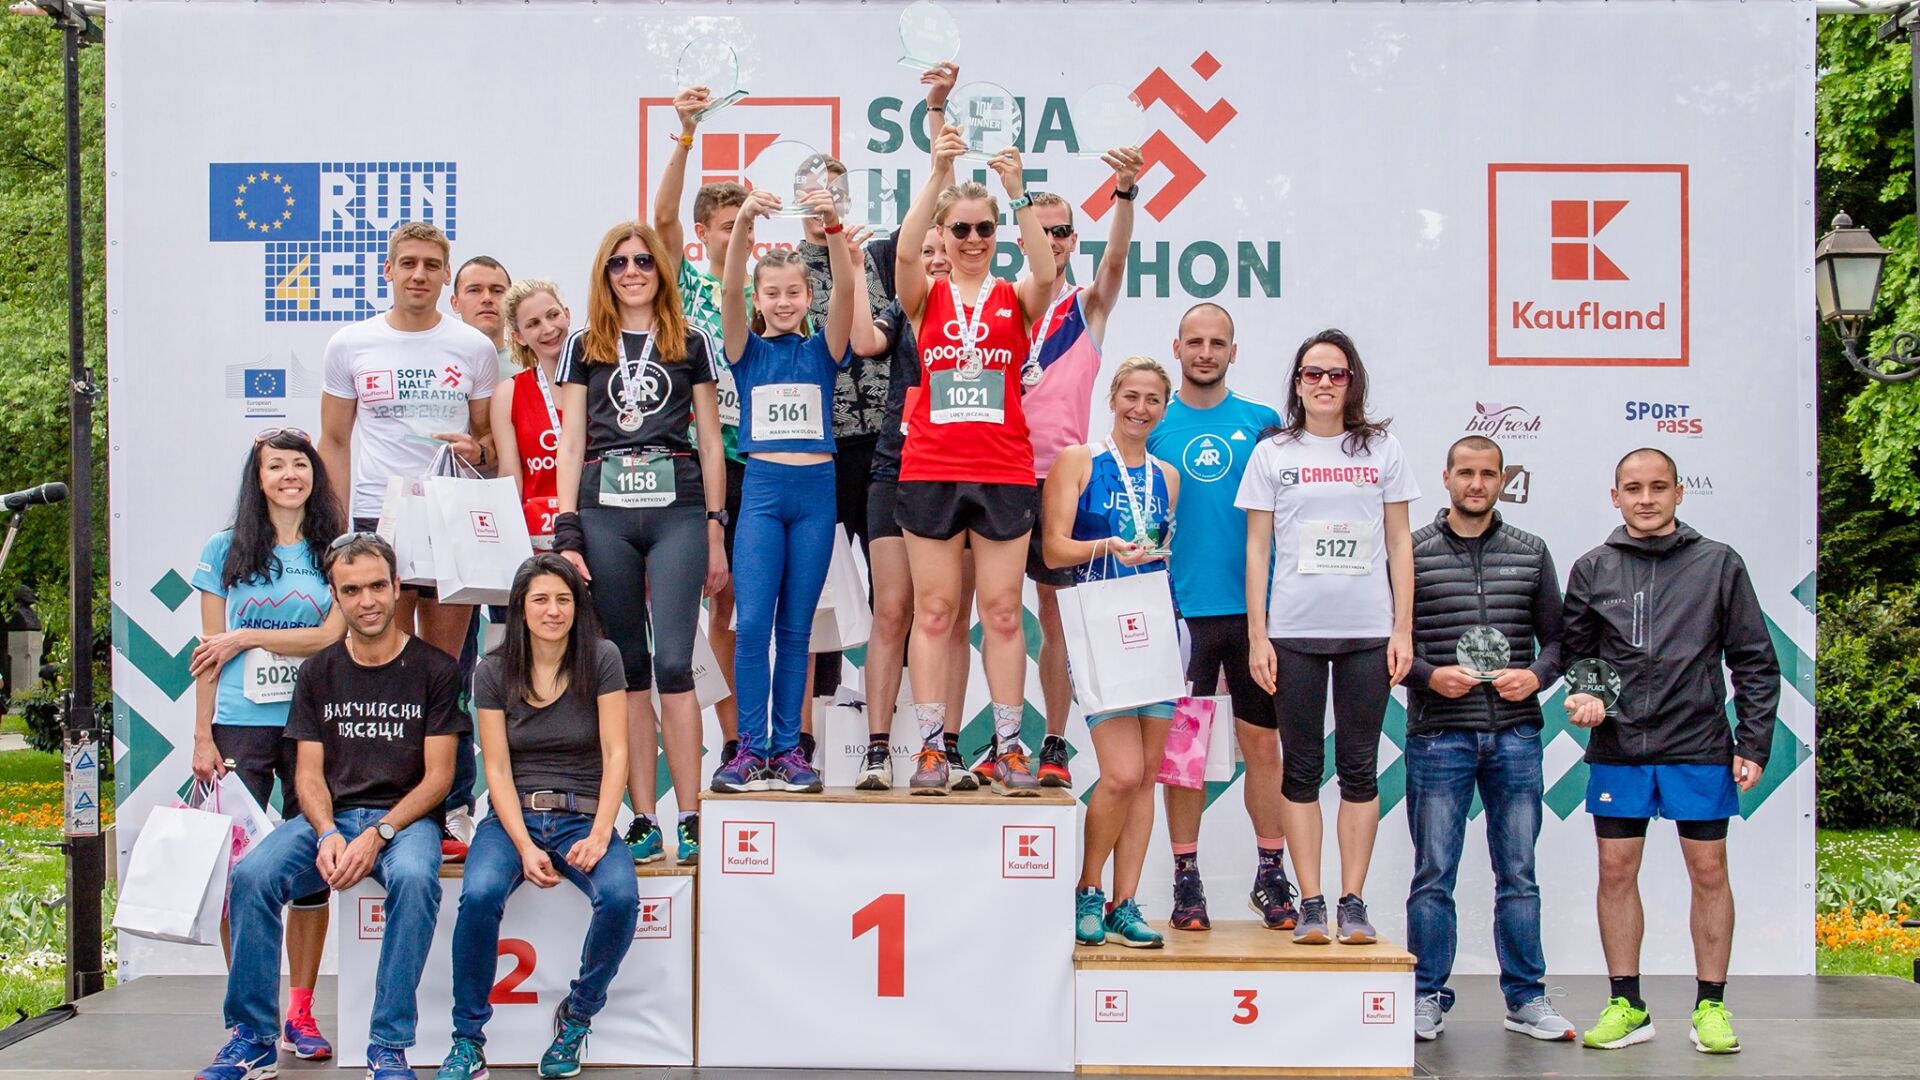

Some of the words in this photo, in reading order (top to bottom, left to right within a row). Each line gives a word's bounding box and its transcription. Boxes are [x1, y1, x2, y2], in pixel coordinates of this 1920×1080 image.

[321, 172, 446, 229] RUN
[1512, 301, 1666, 330] Kaufland
[397, 369, 437, 379] SOFIA
[398, 380, 431, 389] HALF
[399, 390, 469, 402] MARATHON
[946, 387, 988, 406] 1021
[768, 403, 808, 422] 5161
[1625, 400, 1691, 421] SPORT
[617, 471, 658, 491] 1158
[1301, 466, 1379, 484] CARGOTEC
[1315, 539, 1358, 558] 5127
[1587, 672, 1598, 684] 5K
[1587, 684, 1606, 692] PLACE
[727, 857, 769, 866] Kaufland
[1008, 861, 1049, 870] Kaufland
[852, 893, 906, 998] 1
[488, 937, 539, 1004] 2
[1231, 989, 1259, 1025] 3
